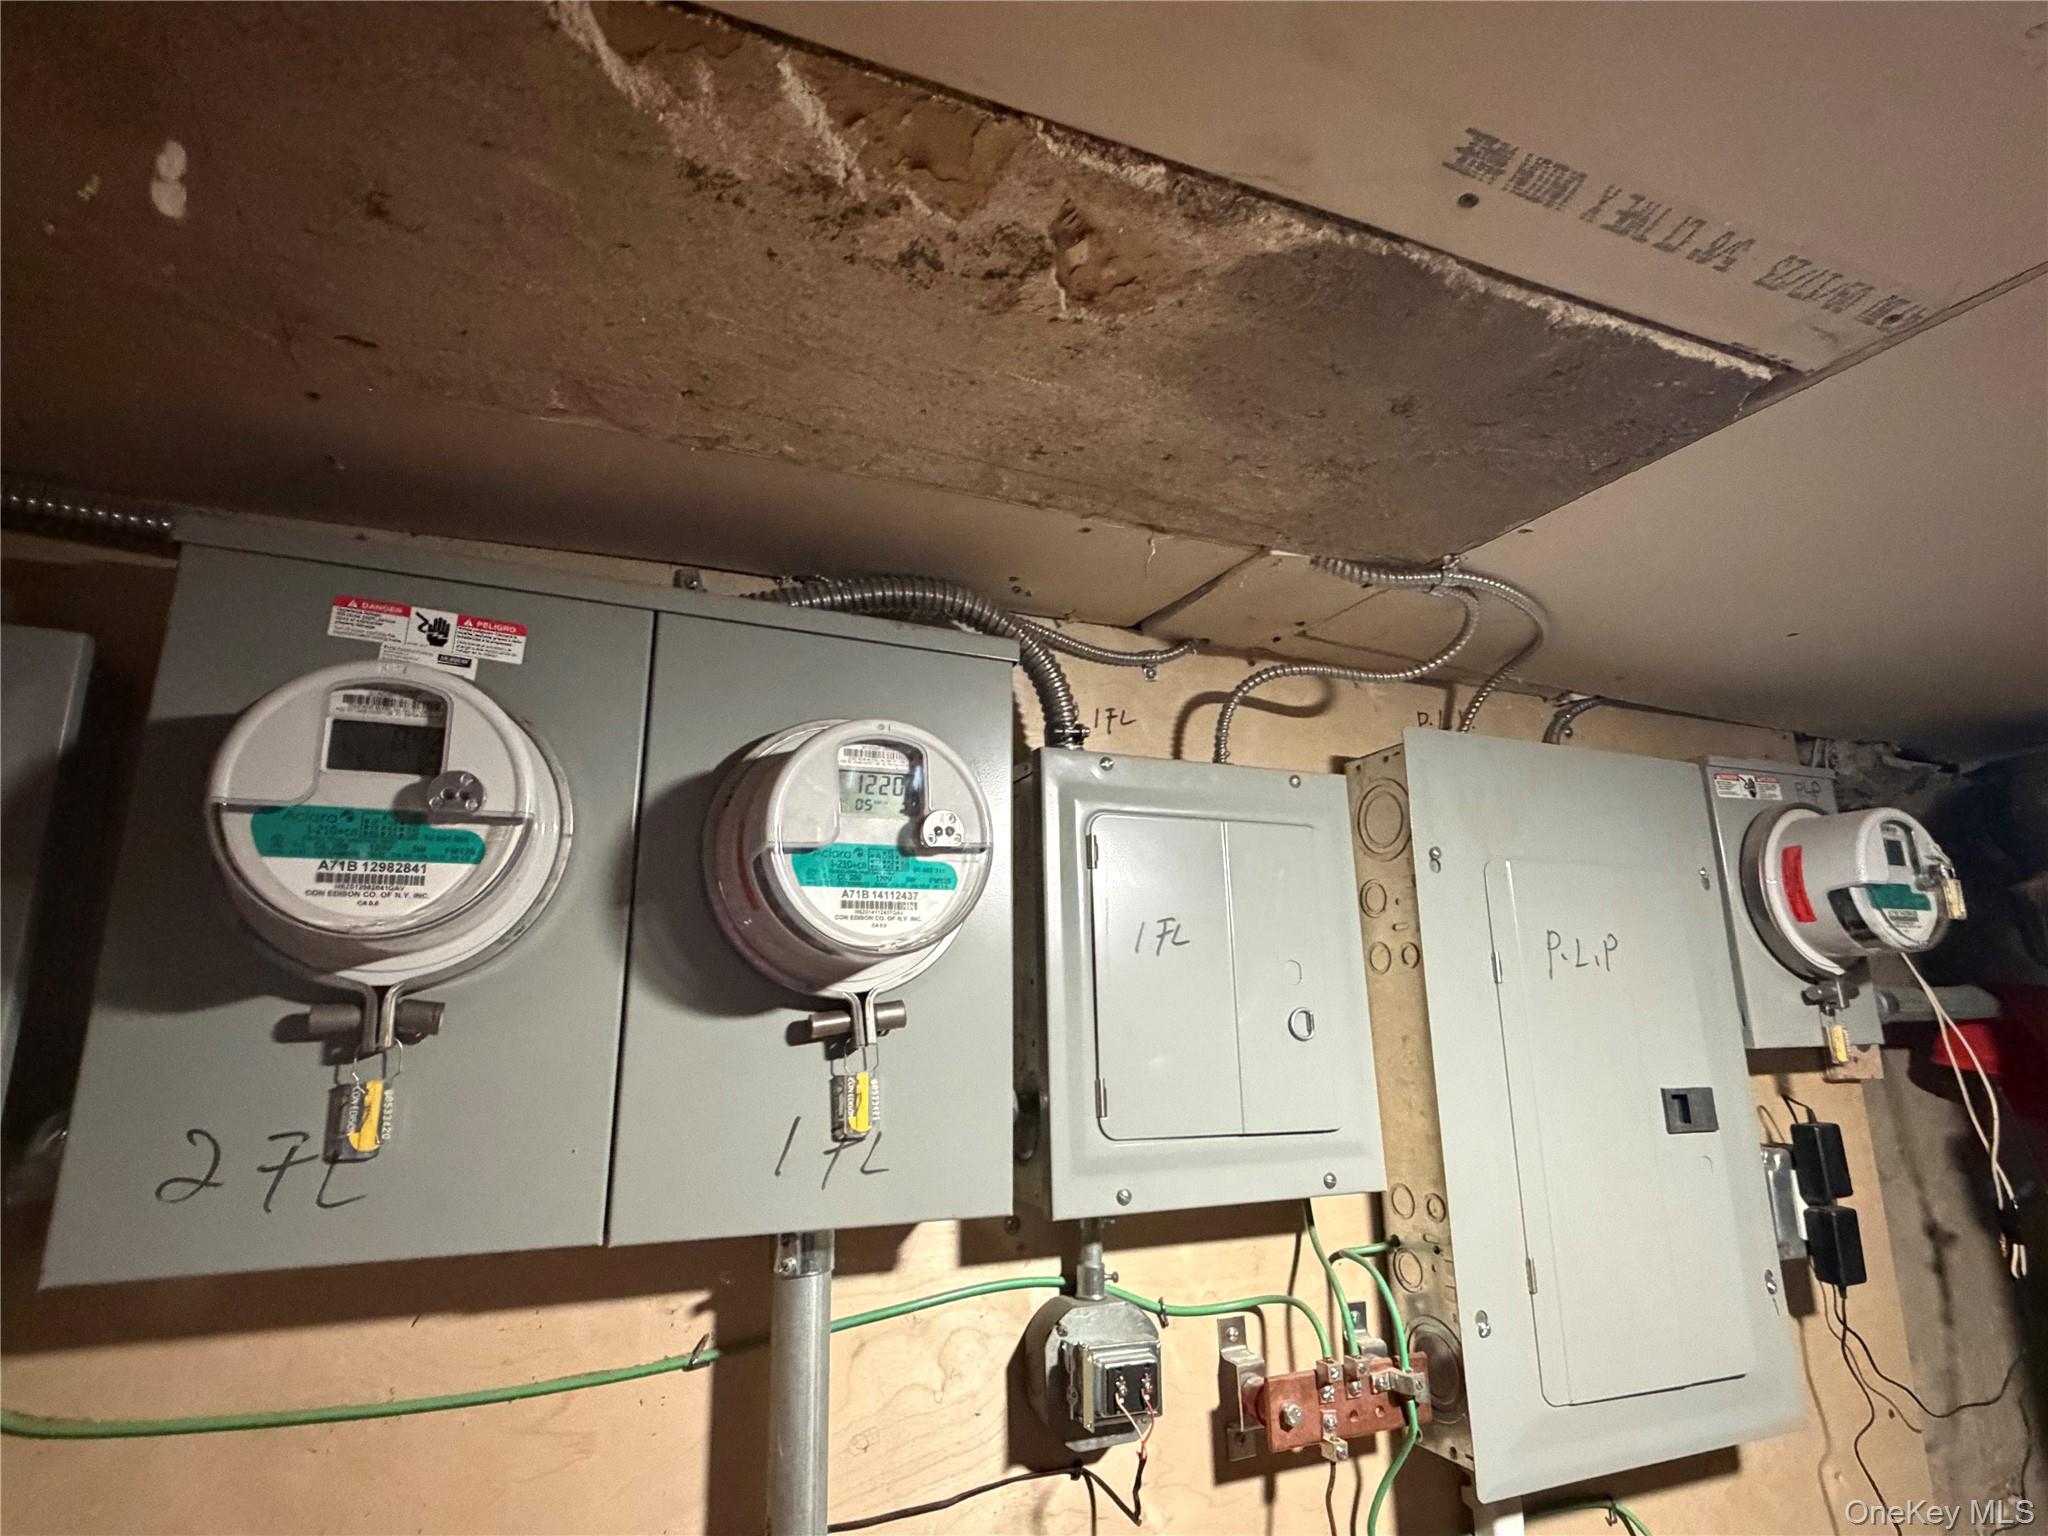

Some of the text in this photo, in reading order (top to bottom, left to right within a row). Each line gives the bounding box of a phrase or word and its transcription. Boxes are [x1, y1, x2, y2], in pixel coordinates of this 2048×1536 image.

[361, 602, 403, 614] DANGER
[475, 621, 518, 633] PELIGRO
[858, 773, 904, 797] 1220
[855, 798, 873, 811] 05
[317, 860, 428, 874] A71B 12982841
[841, 889, 919, 901] A71B 14112437
[155, 1128, 223, 1204] 2
